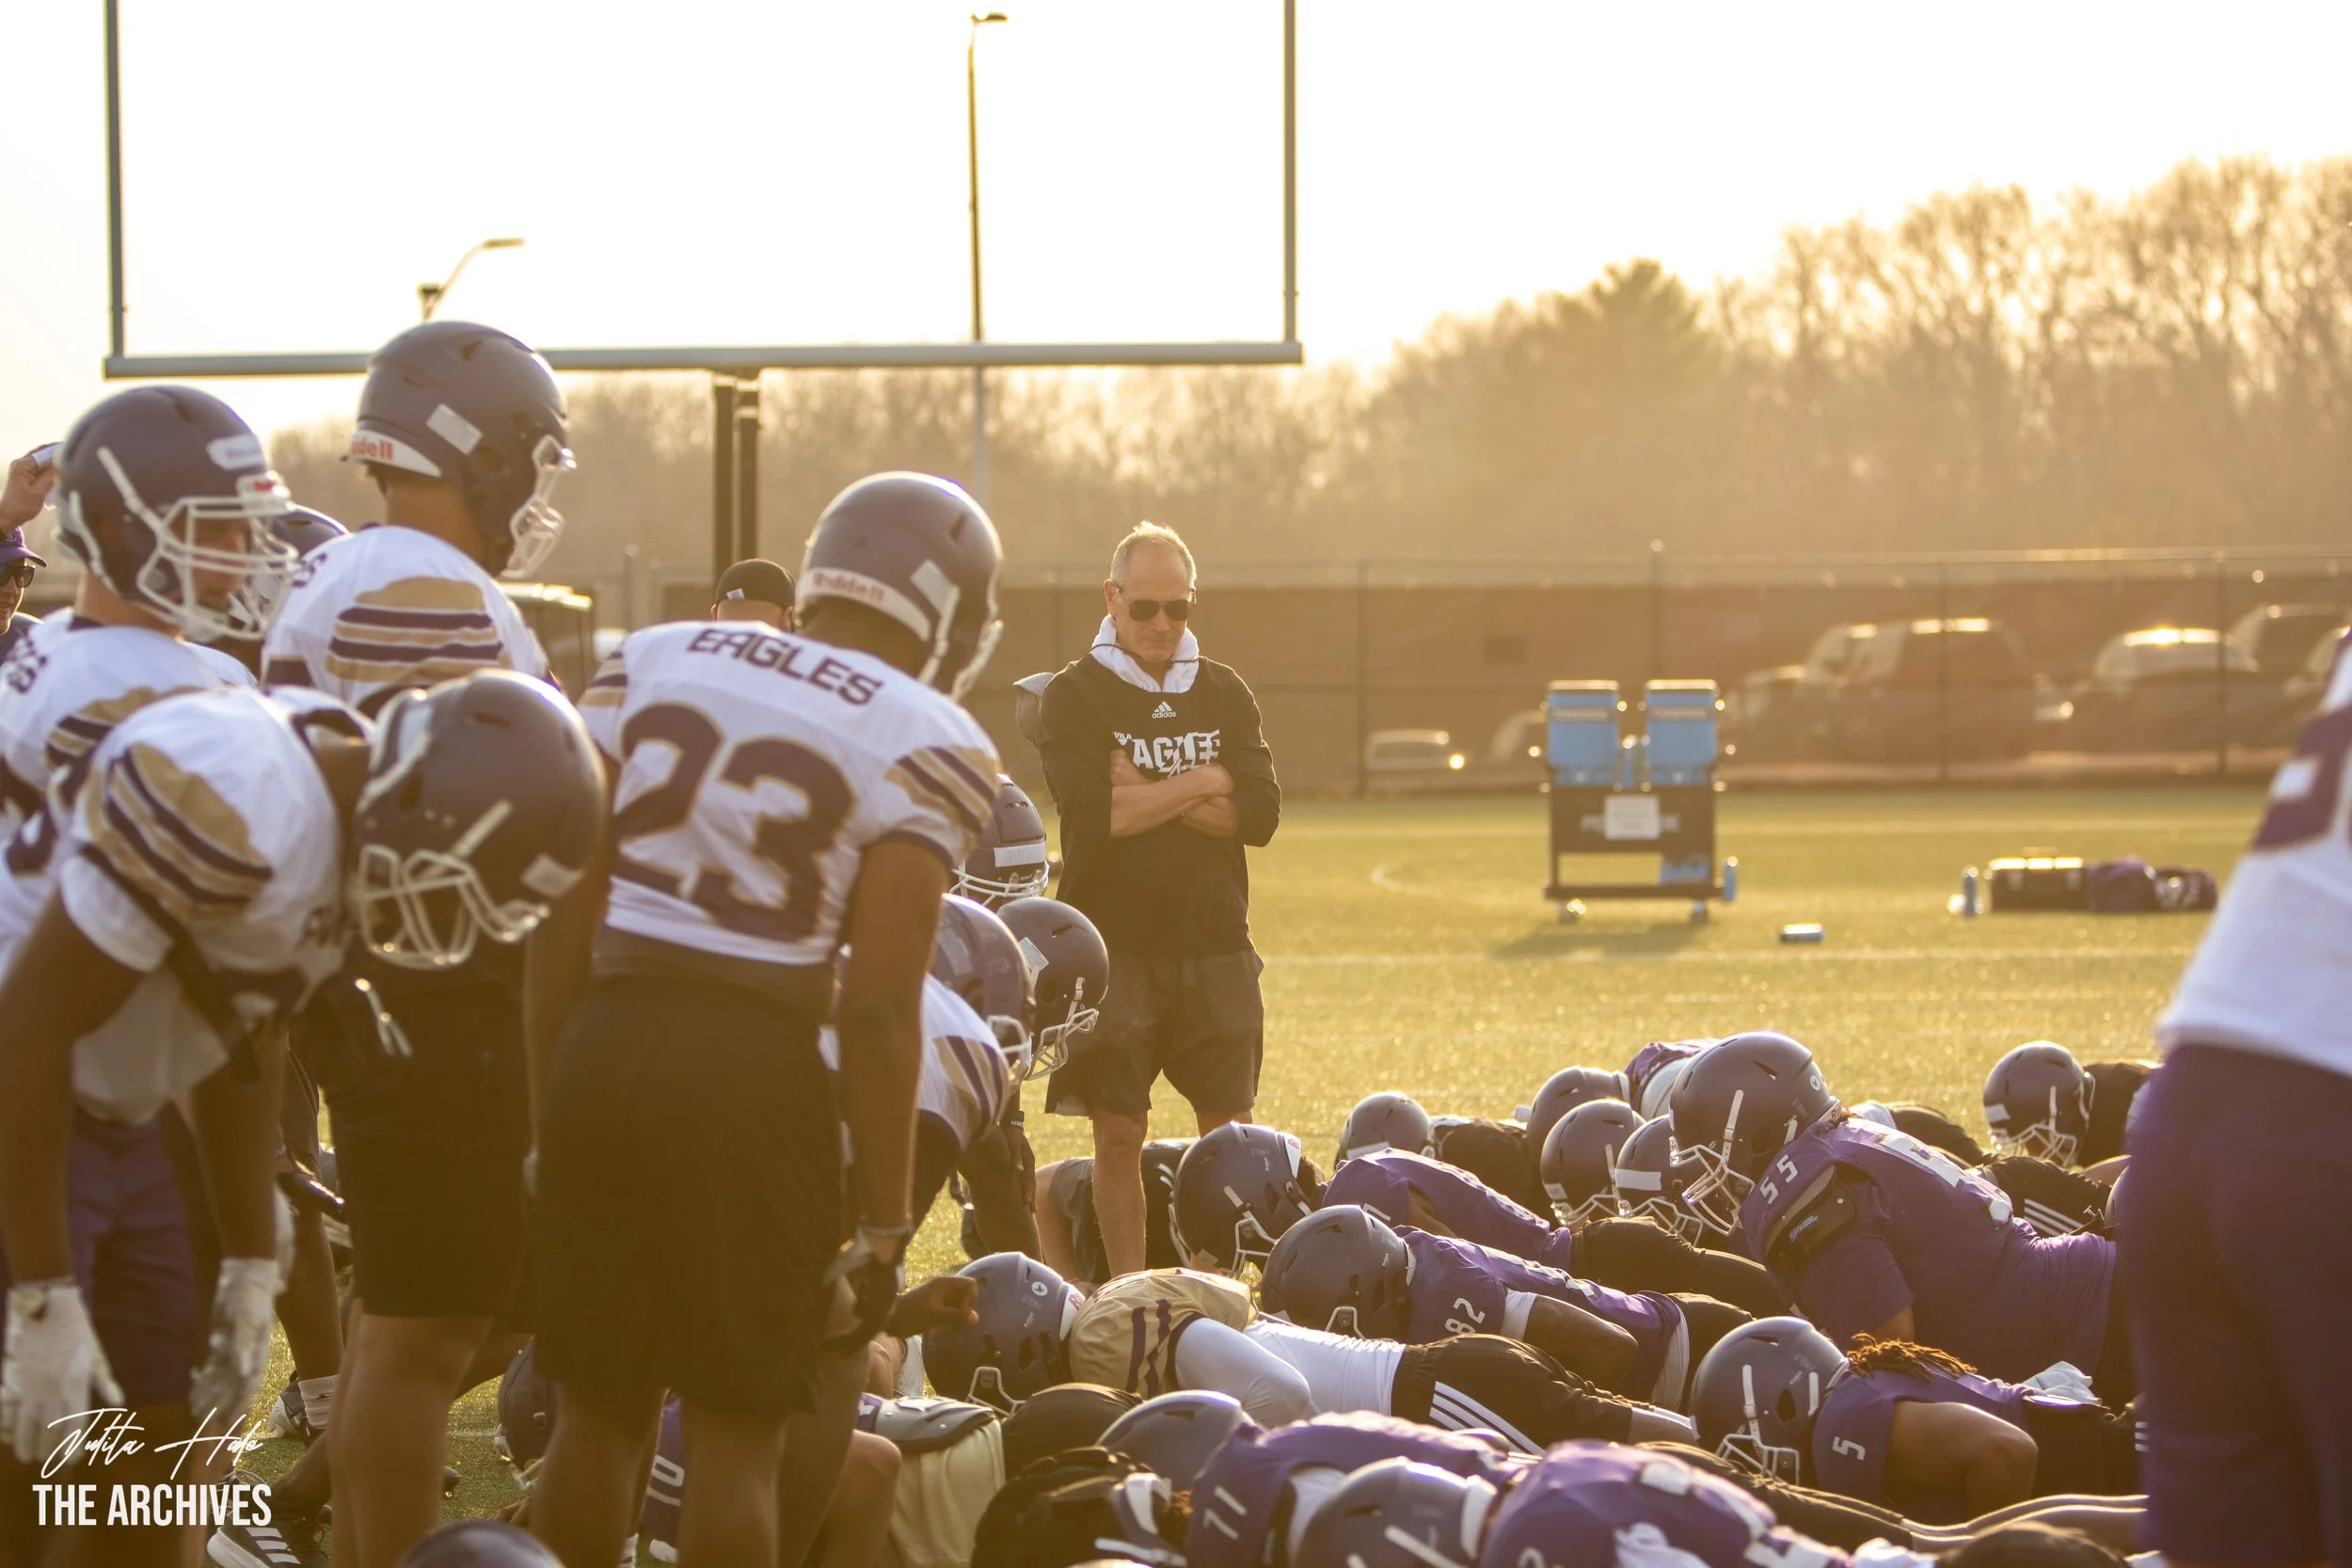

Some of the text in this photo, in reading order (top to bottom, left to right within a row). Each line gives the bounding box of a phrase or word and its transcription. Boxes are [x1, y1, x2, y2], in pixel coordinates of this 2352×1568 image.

[686, 627, 885, 706] EAGLES
[1151, 710, 1177, 719] adidas
[610, 701, 858, 944] 23
[1759, 1153, 1799, 1205] 55
[1444, 1297, 1486, 1335] 82
[1832, 1435, 1867, 1462] 5
[1202, 1486, 1248, 1541] 71
